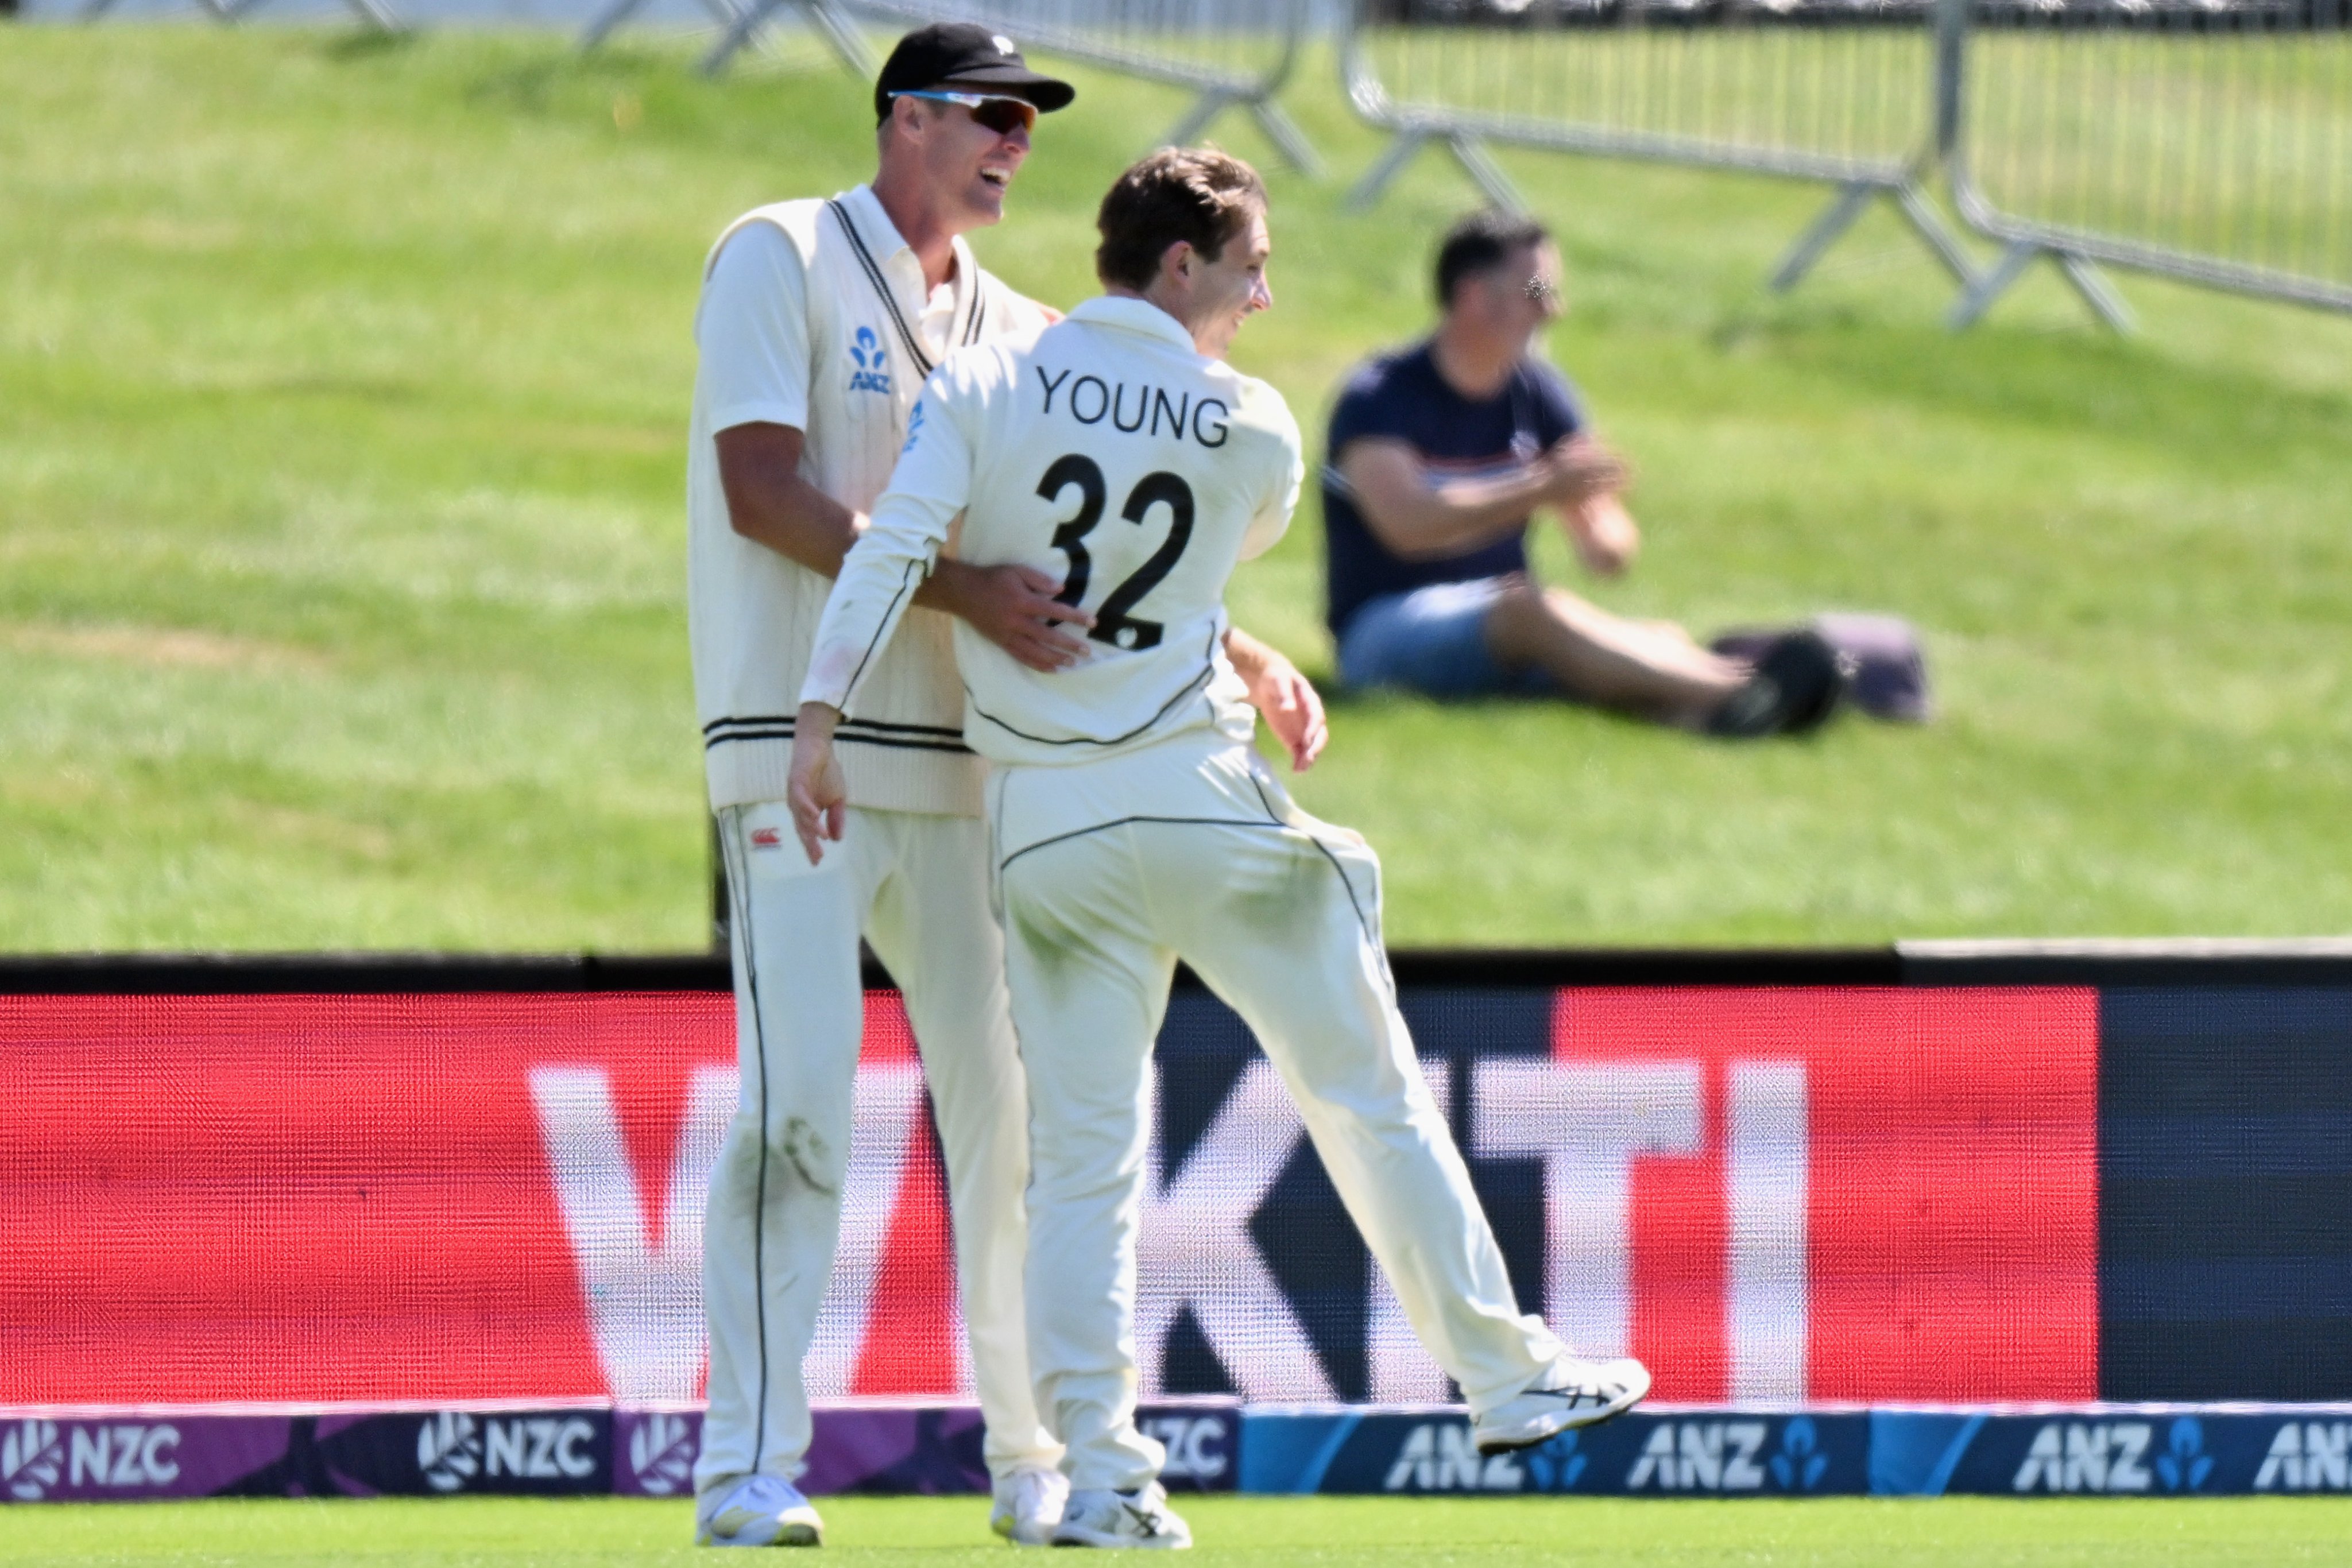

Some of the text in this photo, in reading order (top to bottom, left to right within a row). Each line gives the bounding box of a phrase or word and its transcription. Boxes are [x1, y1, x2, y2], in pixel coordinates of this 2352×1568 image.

[1036, 365, 1229, 448] YOUNG
[1035, 452, 1195, 651] 32
[70, 1424, 181, 1486] NZC
[484, 1417, 595, 1478] NZC
[1142, 1417, 1227, 1476] ZC
[1626, 1422, 1767, 1489] ANZ
[2011, 1422, 2152, 1491] ANZ
[2253, 1421, 2352, 1489] AN
